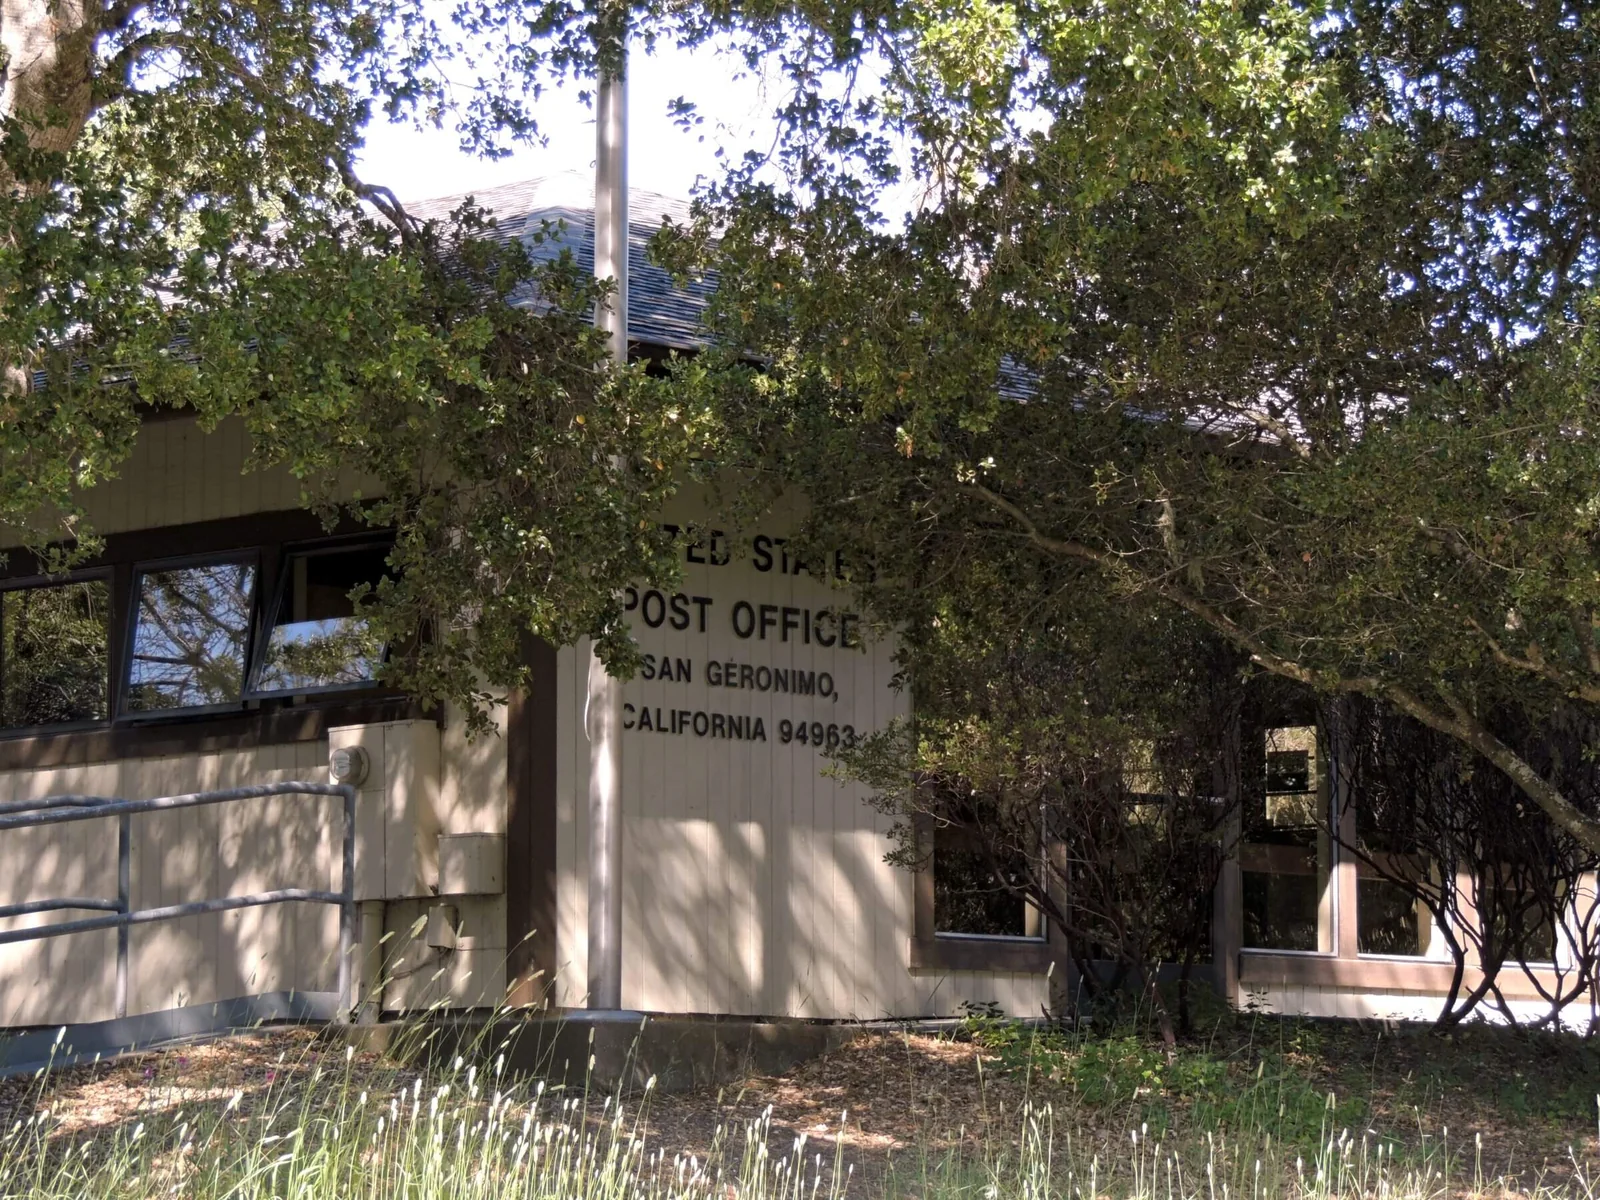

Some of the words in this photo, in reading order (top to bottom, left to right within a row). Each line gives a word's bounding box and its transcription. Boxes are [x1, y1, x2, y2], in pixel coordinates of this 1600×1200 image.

[732, 600, 860, 648] OFFICE
[641, 654, 692, 684] SAN
[623, 703, 767, 742] CALIFORNIA
[779, 719, 855, 748] 94963
